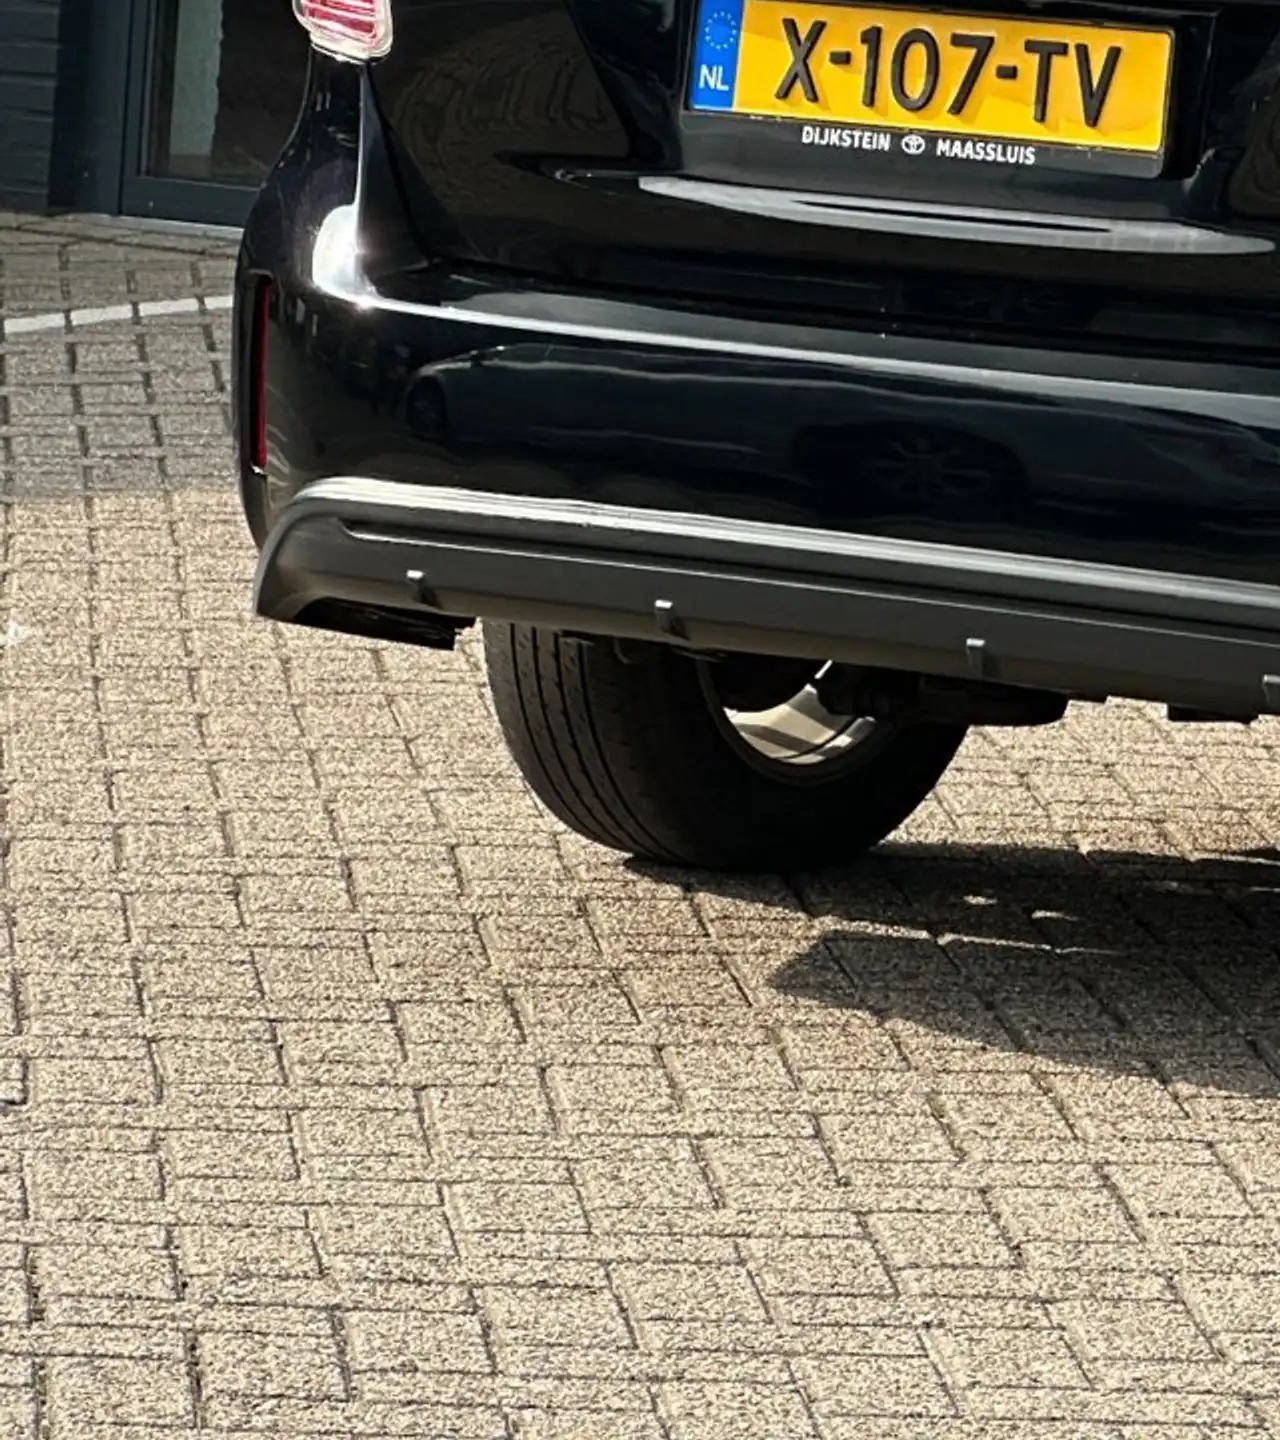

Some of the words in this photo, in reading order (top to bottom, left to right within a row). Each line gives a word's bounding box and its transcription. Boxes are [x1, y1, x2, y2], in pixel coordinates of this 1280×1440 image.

[700, 63, 730, 93] NL
[774, 17, 1123, 128] X-107-TV
[801, 125, 891, 152] DIJKSTEIN
[936, 138, 1037, 166] MAASSLUIS
